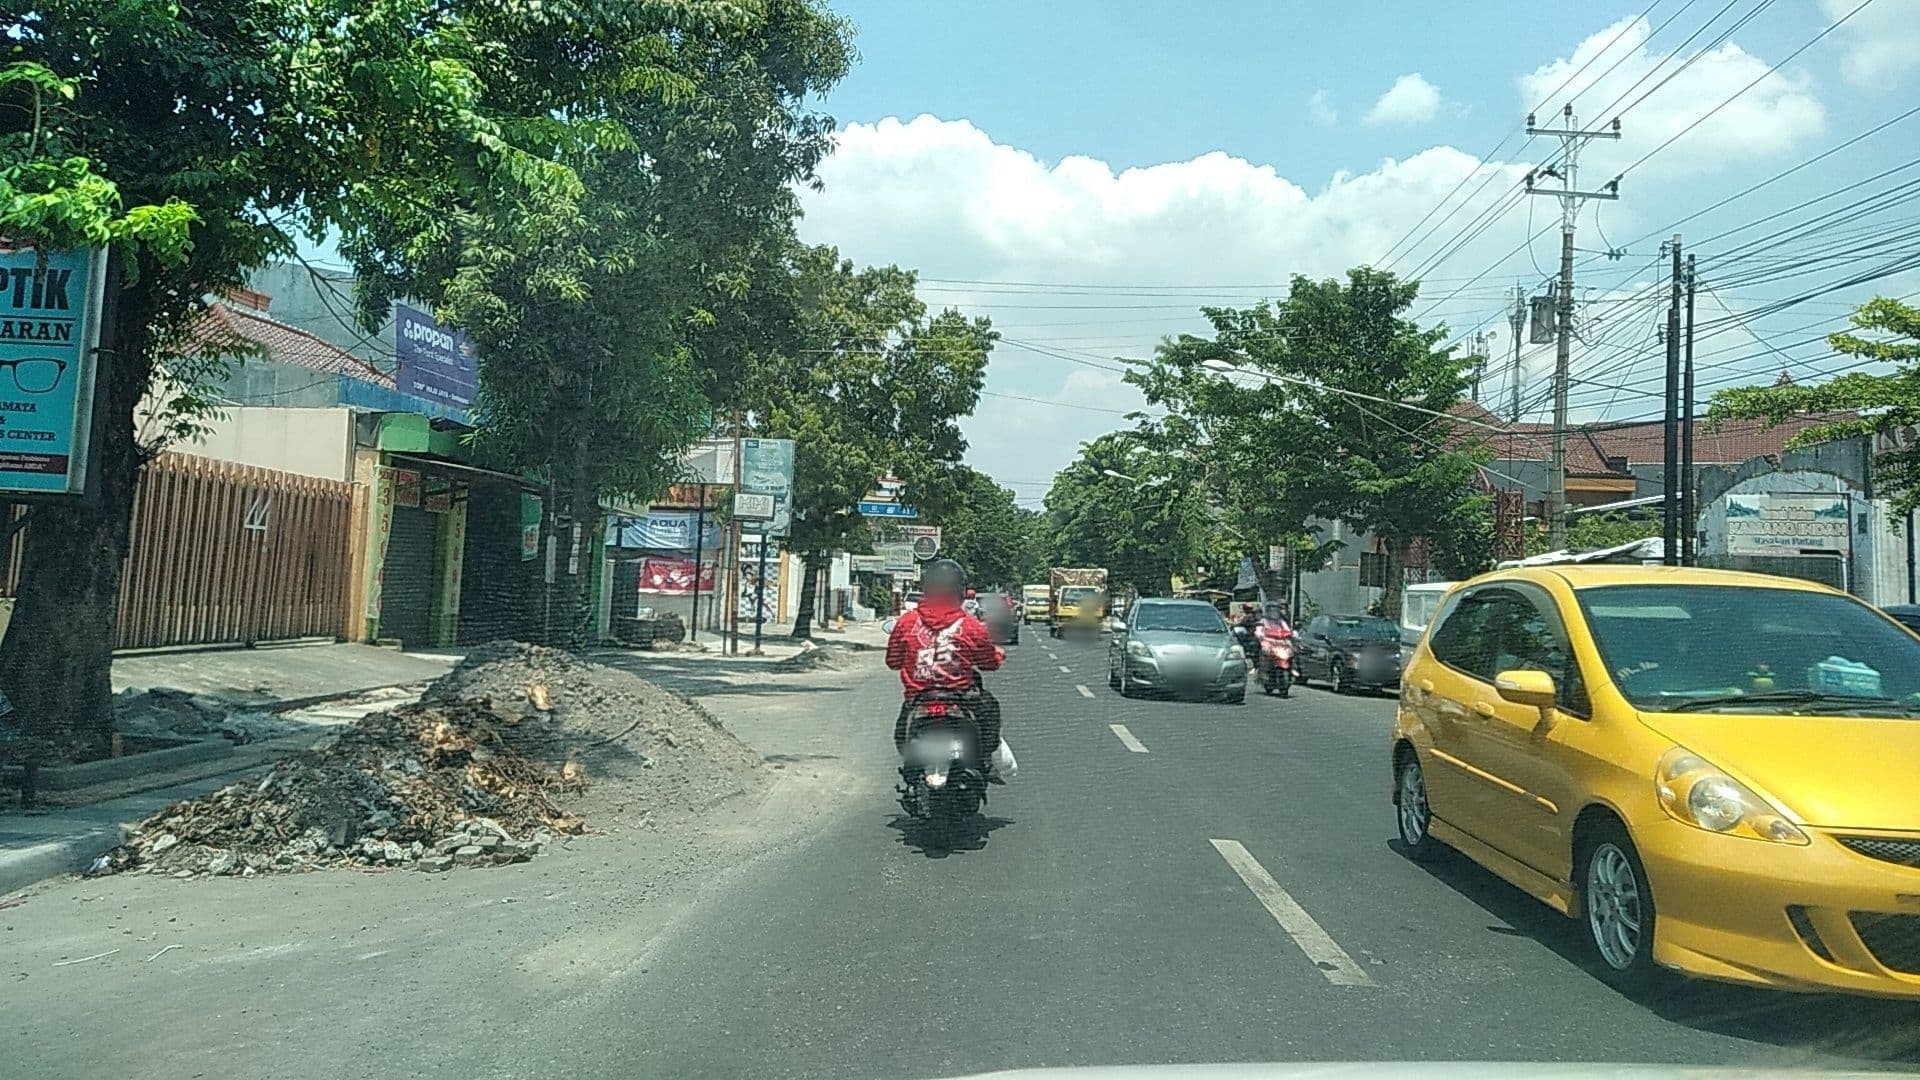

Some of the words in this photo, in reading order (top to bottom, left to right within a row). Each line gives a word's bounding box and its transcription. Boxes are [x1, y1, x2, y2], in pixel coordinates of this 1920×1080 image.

[414, 322, 454, 352] propan
[7, 430, 57, 441] CENTER
[243, 496, 271, 543] 44
[649, 519, 688, 528] AQUA
[1798, 522, 1848, 537] INDAH
